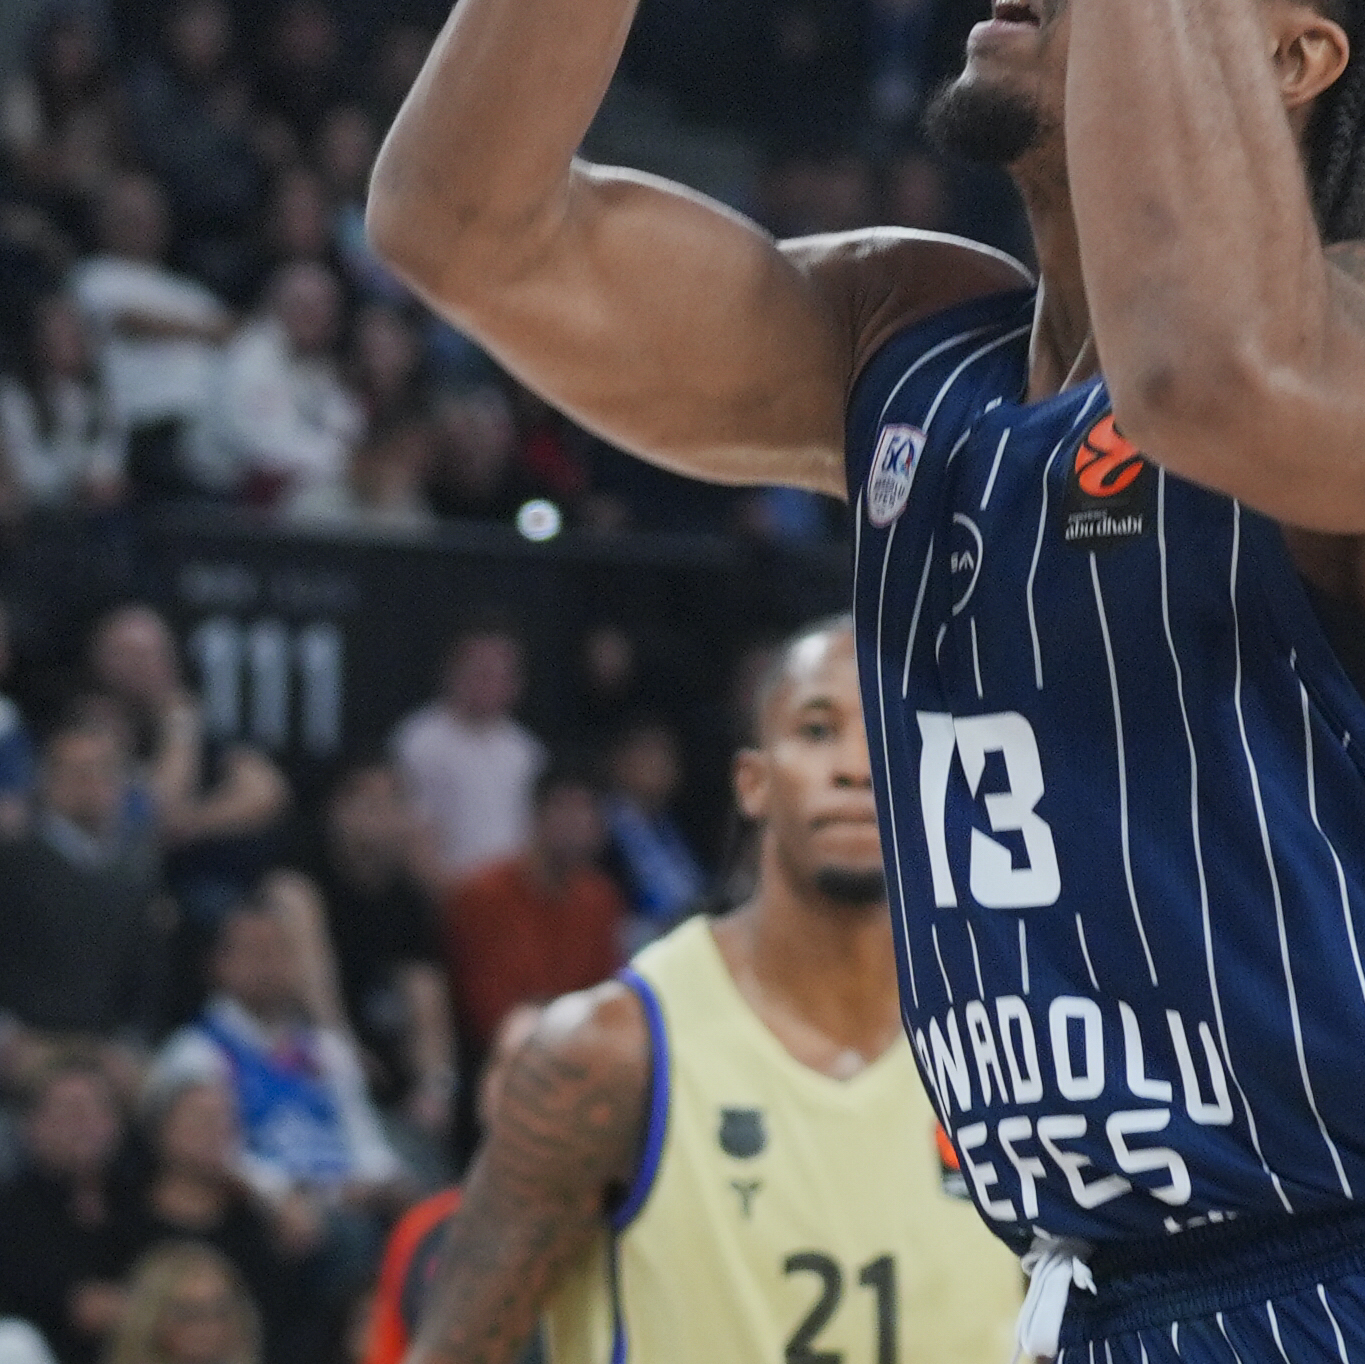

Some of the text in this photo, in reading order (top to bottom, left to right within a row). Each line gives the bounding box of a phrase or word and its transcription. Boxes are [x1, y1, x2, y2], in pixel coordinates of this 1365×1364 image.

[916, 710, 1061, 910] 13
[956, 1108, 1191, 1222] EFES
[783, 1250, 898, 1364] 21
